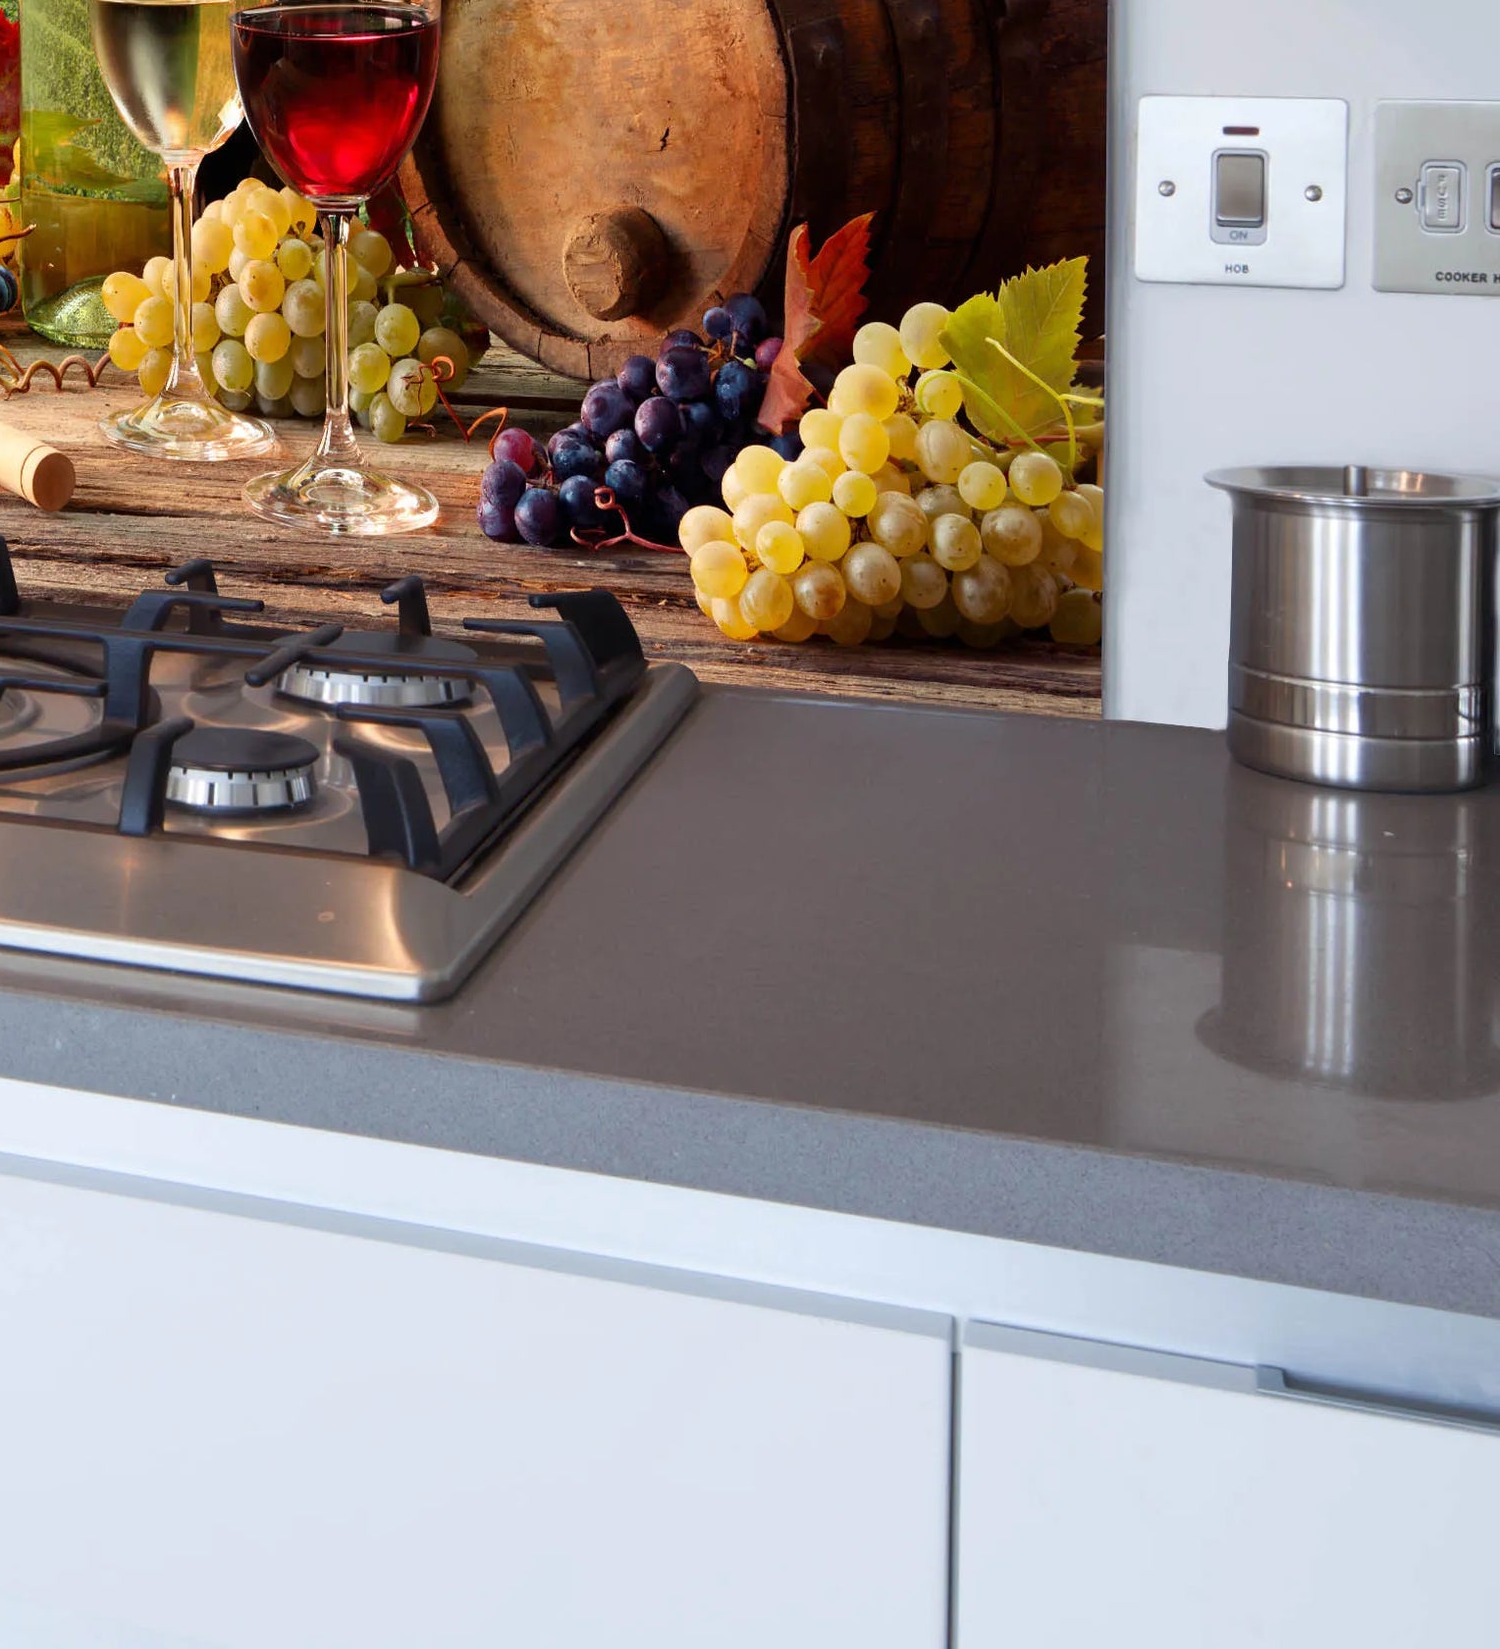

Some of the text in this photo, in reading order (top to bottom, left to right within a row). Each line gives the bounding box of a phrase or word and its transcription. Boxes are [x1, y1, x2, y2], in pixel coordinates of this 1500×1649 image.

[1229, 230, 1248, 241] ON
[1224, 263, 1250, 274] HOB
[1435, 271, 1488, 283] COOKER
